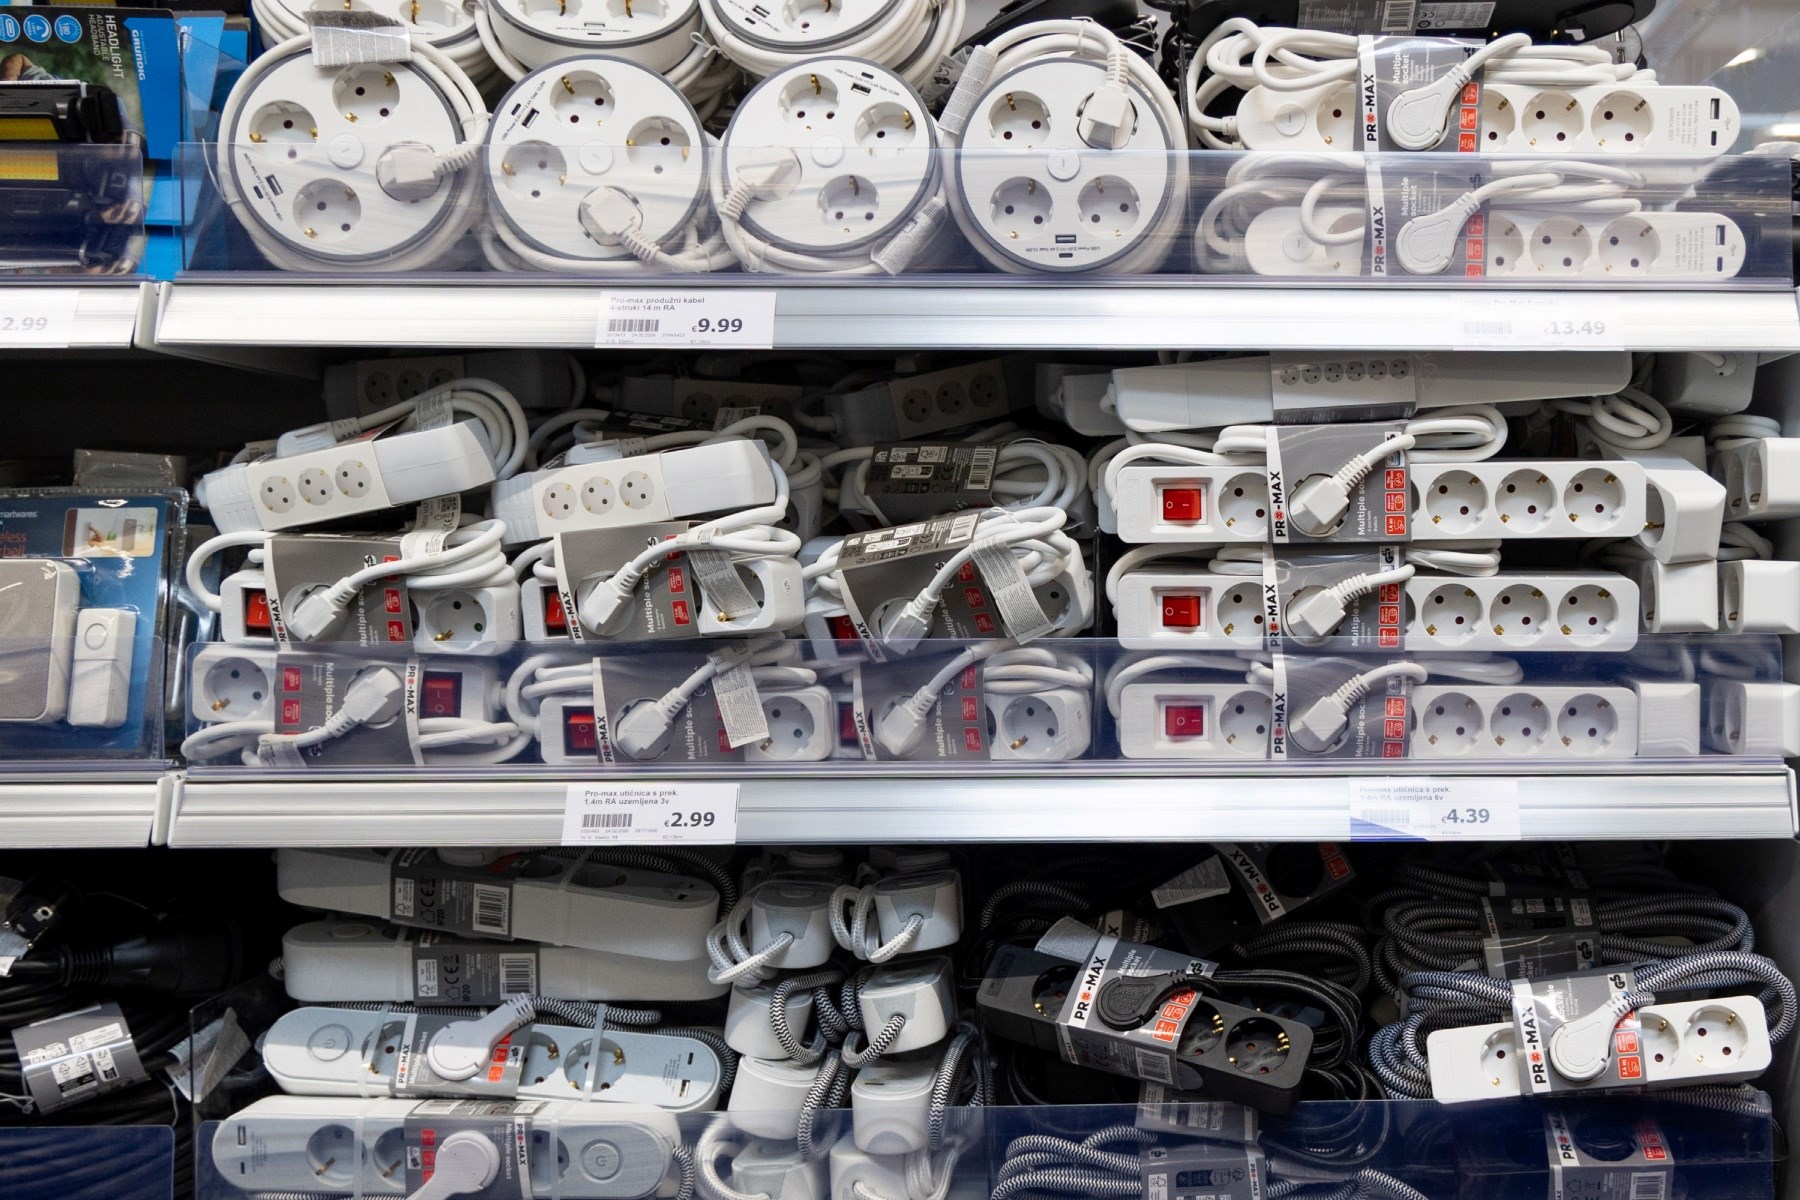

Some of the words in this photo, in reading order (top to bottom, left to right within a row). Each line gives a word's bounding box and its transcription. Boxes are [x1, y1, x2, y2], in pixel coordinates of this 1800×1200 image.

[88, 14, 100, 56] HEADBAND
[96, 14, 110, 61] ADJUSTABLE
[104, 15, 124, 80] HEADLIGHT
[131, 29, 146, 81] GRUNDIG
[1393, 47, 1402, 84] Multiple
[1402, 54, 1410, 84] socket
[1364, 74, 1377, 141] PRO-MAX
[1372, 206, 1384, 273] PRO-MAX
[1, 317, 48, 331] 2.99
[692, 318, 743, 333] €9.99
[1270, 471, 1286, 537] PRO-MAX
[1358, 496, 1366, 535] Multiple
[562, 591, 581, 639] PRO-MAX
[645, 594, 655, 633] Multiple
[1265, 585, 1280, 647] PRO-MAX
[1351, 612, 1360, 646] Multiple
[324, 662, 335, 705] Multiple
[407, 666, 417, 714] PRO-MAX
[598, 716, 613, 763] PRO-MAX
[685, 720, 696, 760] Multiple
[856, 712, 874, 755] PRO-MAX
[935, 719, 946, 756] Multiple
[1274, 693, 1285, 754] PRO-MAX
[1355, 722, 1366, 757] Multiple
[664, 812, 715, 827] €2.99
[1442, 808, 1489, 824] €4.39
[1229, 850, 1280, 912] PRO-MAX
[1117, 949, 1136, 975] Multiple
[1127, 956, 1142, 976] socket
[1074, 956, 1107, 1020] PRO-MAX
[399, 1044, 410, 1084] PRO-MAX
[1522, 1006, 1547, 1084] PRO-MAX
[409, 1054, 422, 1084] Multiple
[516, 1124, 526, 1165] PRO-MAX
[1250, 1164, 1259, 1196] PRO-MAX
